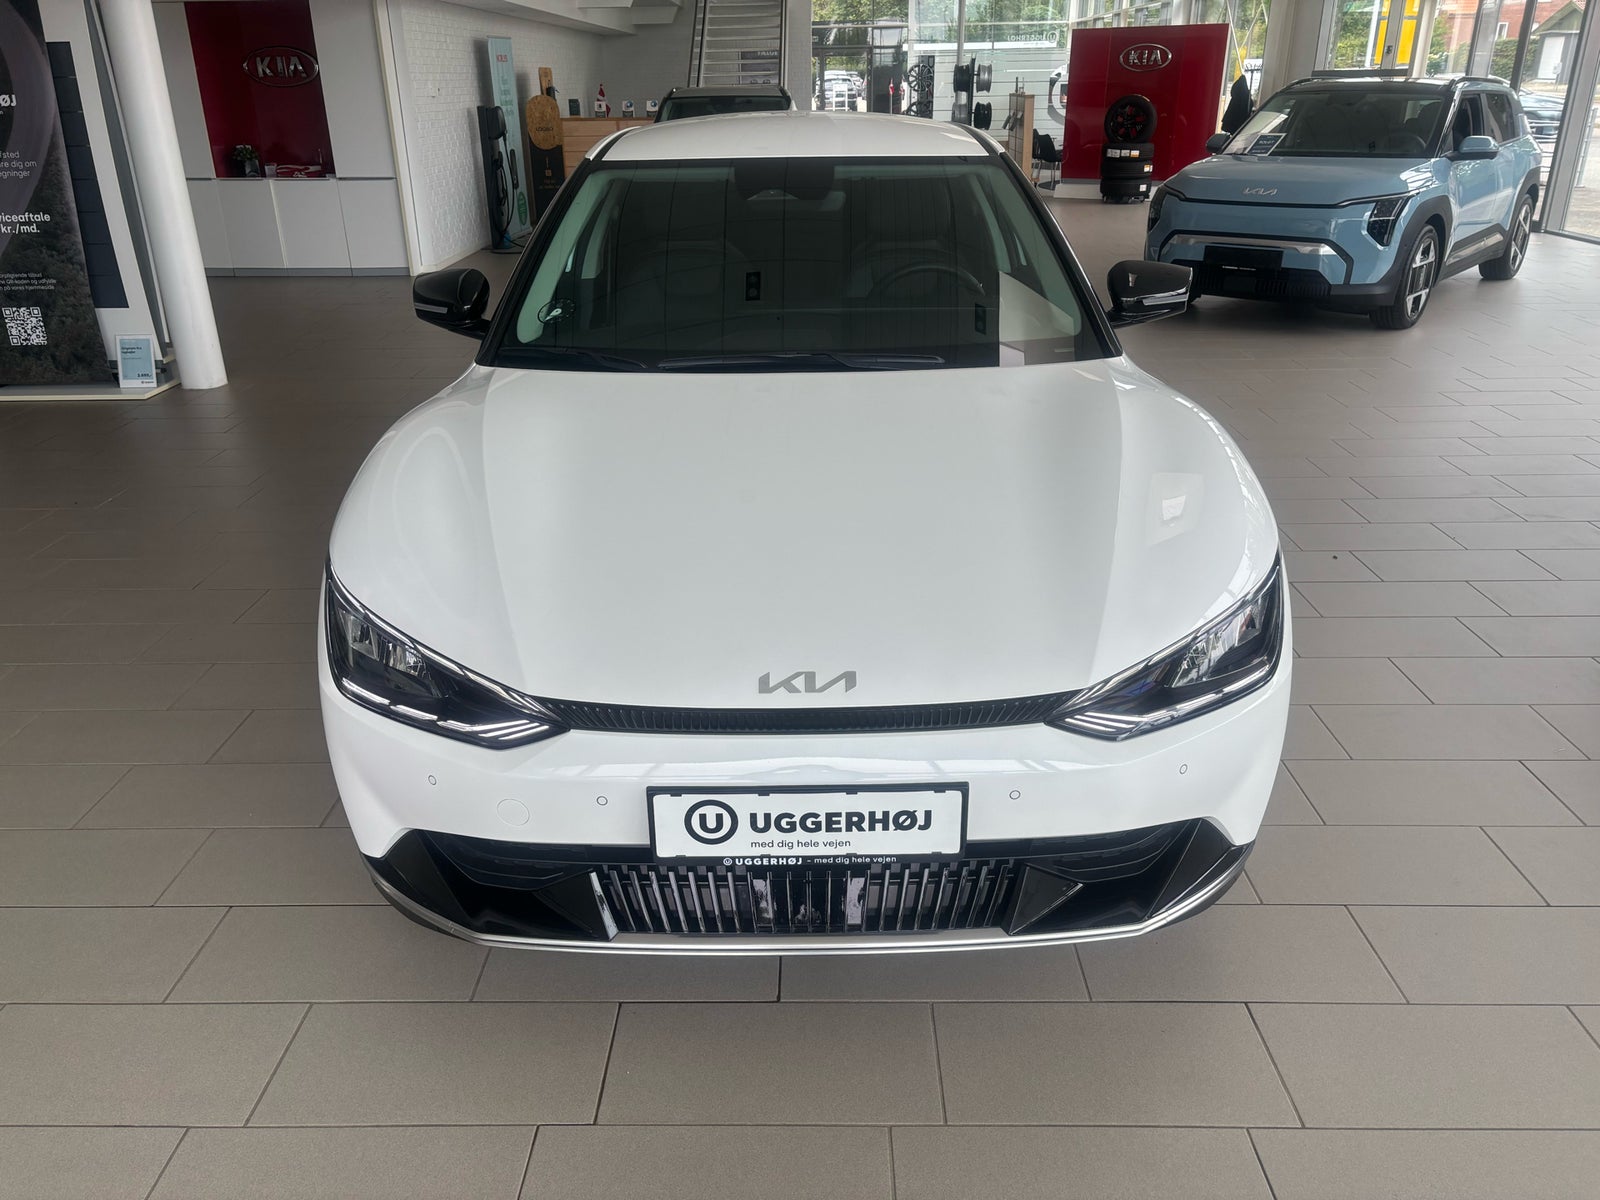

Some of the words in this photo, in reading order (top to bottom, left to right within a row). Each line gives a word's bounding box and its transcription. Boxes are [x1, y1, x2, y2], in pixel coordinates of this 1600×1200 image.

[1128, 50, 1162, 65] KIA
[256, 56, 307, 78] KIA
[10, 160, 23, 169] dig
[0, 212, 50, 222] iceaftale
[0, 223, 40, 234] kr./md.
[759, 671, 856, 694] KIA
[750, 810, 932, 833] UGGERHØJ
[777, 840, 794, 850] dig
[797, 840, 819, 848] hele
[822, 840, 851, 848] vejen
